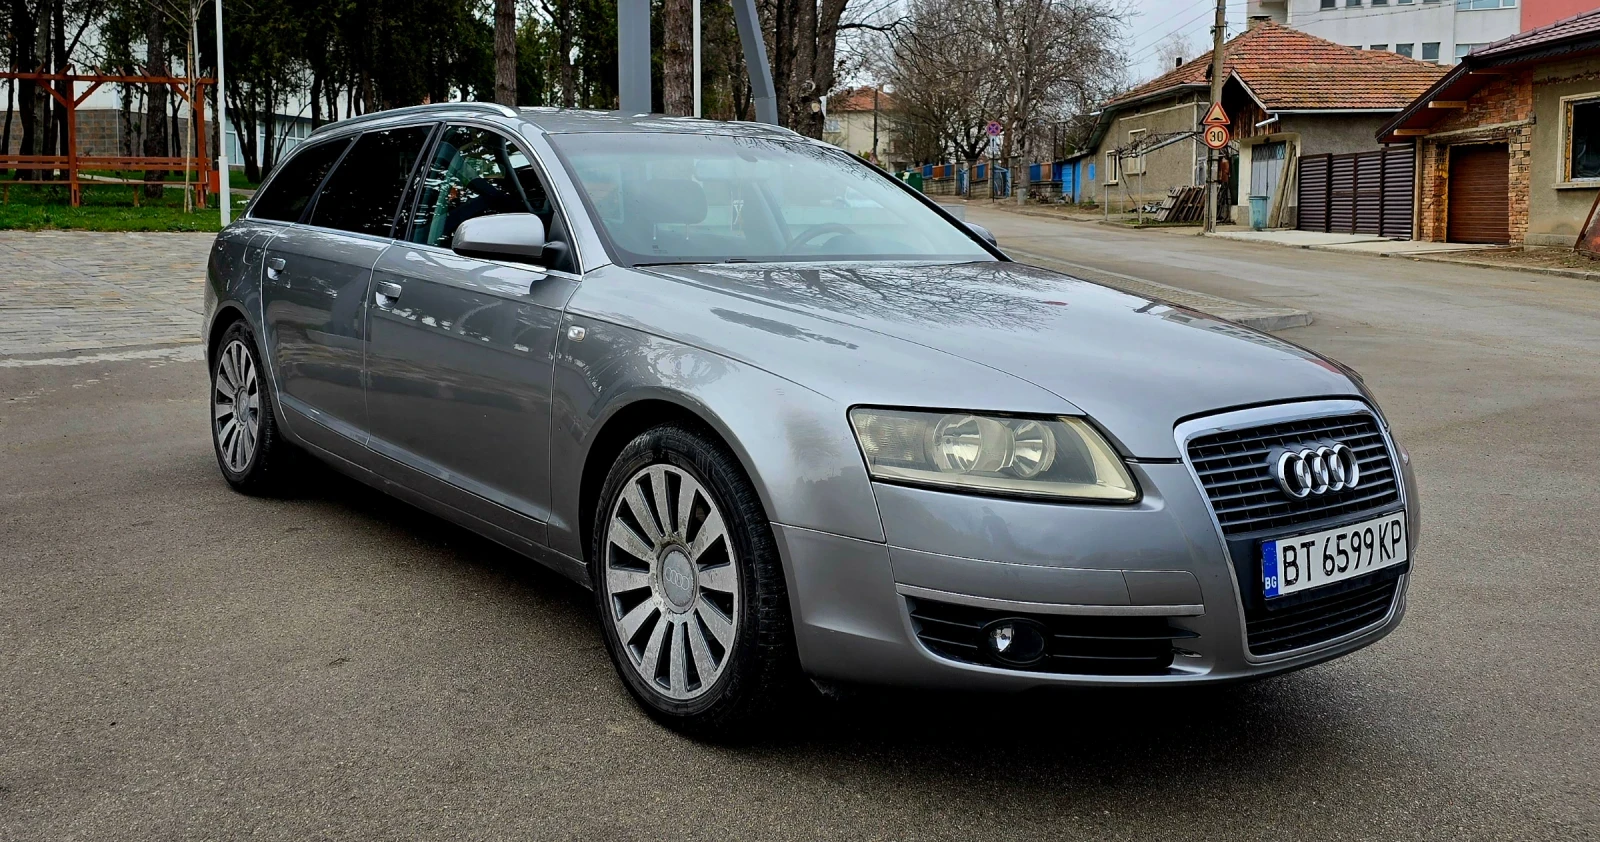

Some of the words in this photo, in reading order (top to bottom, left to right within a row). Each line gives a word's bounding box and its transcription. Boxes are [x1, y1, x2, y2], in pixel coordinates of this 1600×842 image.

[1210, 131, 1223, 142] 30
[1282, 540, 1315, 587] BT
[1322, 527, 1374, 577] 6599
[1378, 519, 1402, 563] KP
[1264, 576, 1278, 590] BG
